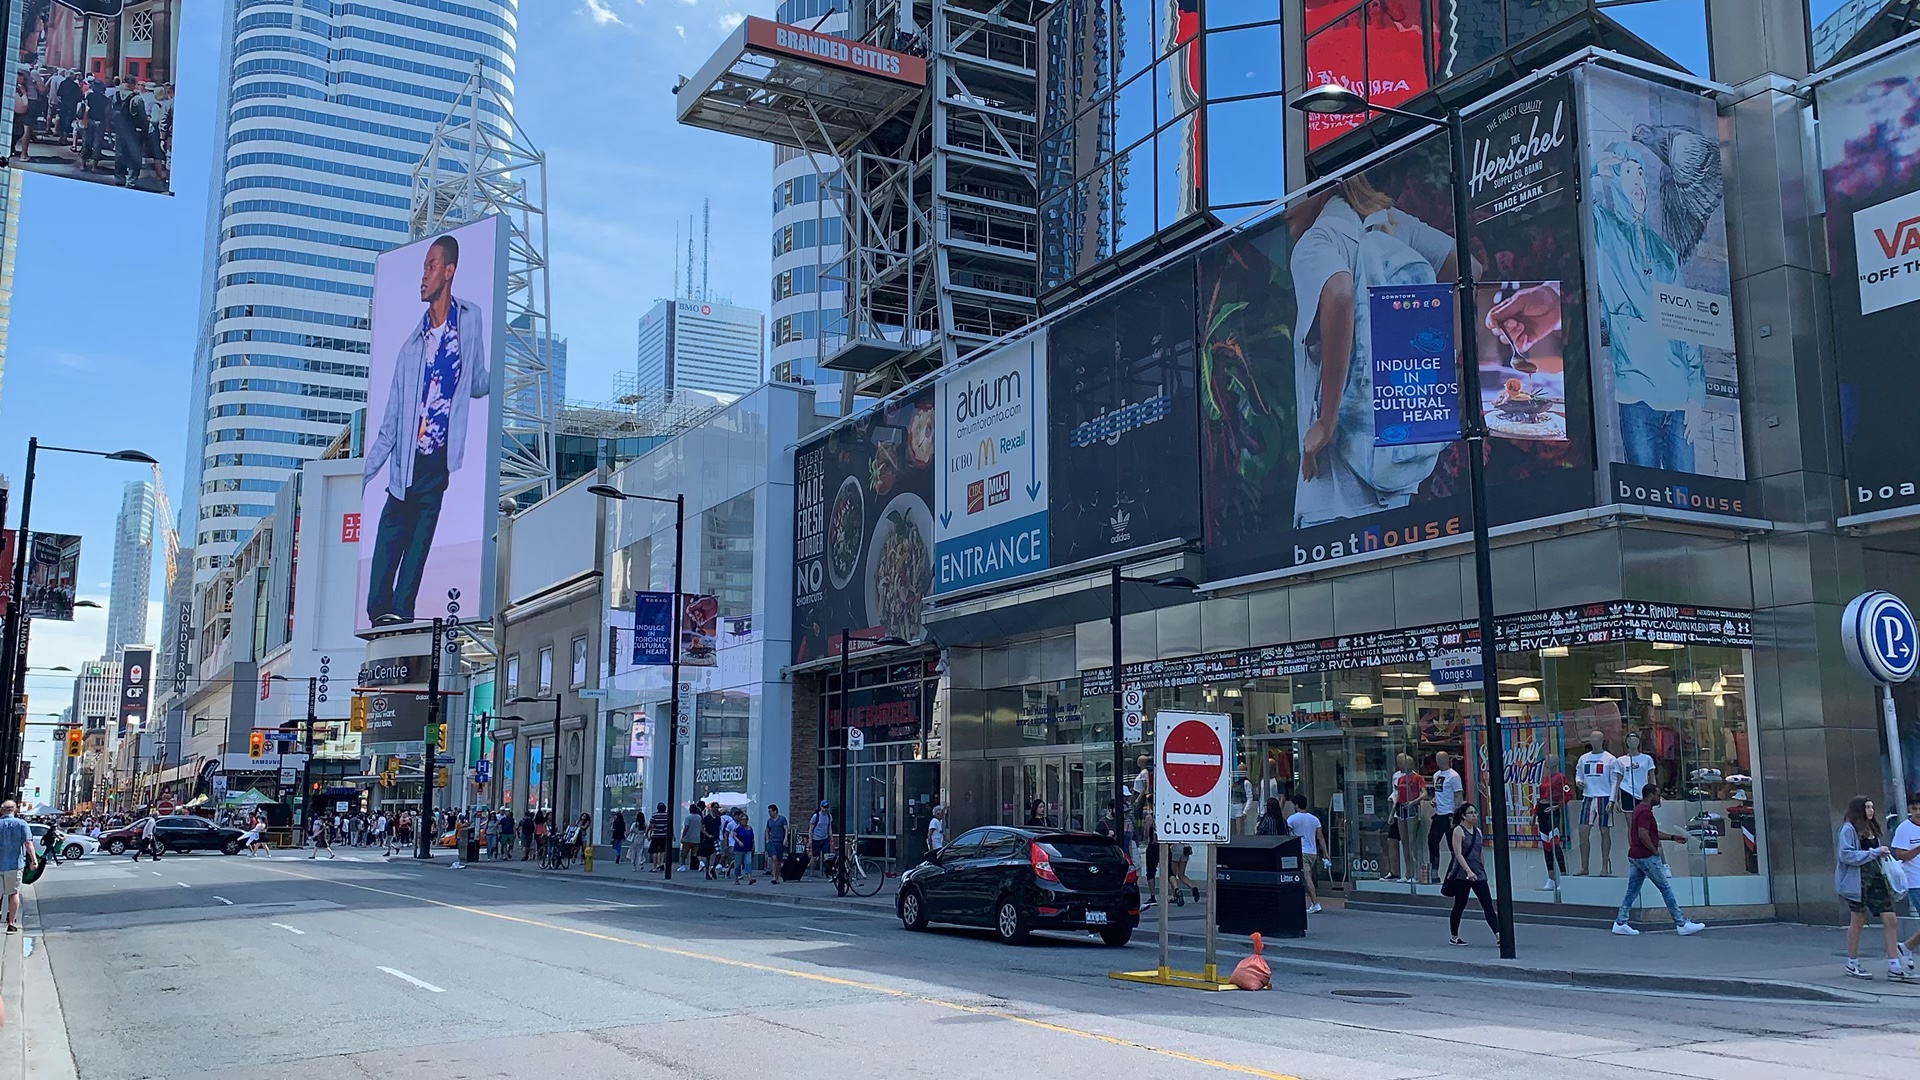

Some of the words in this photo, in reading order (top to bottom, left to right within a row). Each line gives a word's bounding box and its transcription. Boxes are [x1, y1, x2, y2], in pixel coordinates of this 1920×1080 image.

[777, 27, 848, 62] BRANDED
[851, 43, 900, 75] CITIES
[1486, 118, 1498, 133] THE
[1497, 105, 1518, 125] FINEST
[1518, 99, 1543, 114] QUALITY
[1510, 133, 1521, 146] THE
[1468, 100, 1565, 198] Herschel
[1493, 172, 1513, 189] SUPPLY
[1514, 169, 1523, 180] CO.
[1524, 160, 1543, 176] BRAND
[1493, 196, 1518, 212] TRADE
[1520, 184, 1544, 202] MARK
[1659, 292, 1692, 309] RVCA
[679, 302, 700, 312] BMO
[1376, 357, 1441, 372] INDULGE
[1404, 372, 1419, 383] IN
[956, 370, 1021, 423] atrium
[1375, 383, 1458, 398] TORONTO'S
[1372, 397, 1446, 411] CULTURAL
[956, 403, 1022, 439] atriumtoronto.com
[1403, 409, 1451, 422] HEART
[1000, 429, 1026, 454] Rexall
[799, 446, 825, 469] EVERY
[951, 450, 973, 473] LCBO
[798, 460, 825, 483] MEAL
[968, 483, 983, 498] CIBC
[988, 473, 1009, 496] MUJI
[798, 475, 825, 510] MADE
[1618, 480, 1743, 513] boathouse
[798, 502, 824, 540] FRESH
[1110, 532, 1131, 544] adidas
[1294, 516, 1460, 565] boathouse
[797, 539, 805, 560] TO
[805, 533, 824, 557] ORDER
[940, 528, 1041, 584] ENTRANCE
[797, 559, 823, 596] NO
[796, 592, 823, 607] SHORTCUTS
[1583, 604, 1605, 616] VANS
[1696, 609, 1716, 617] NIXON
[1724, 611, 1751, 619] BILLABONG
[1520, 614, 1542, 623] NIXON
[1603, 620, 1625, 628] RVCA
[1625, 619, 1640, 627] FILA
[1641, 620, 1666, 629] RVCA
[1409, 627, 1436, 636] BILLABONG
[1436, 624, 1458, 633] RVCA
[1520, 622, 1536, 630] CALVIN
[1552, 626, 1575, 635] Timberland
[1666, 620, 1690, 631] CALVIN
[1690, 622, 1709, 632] KLEIN
[1442, 633, 1462, 645] OBEY
[1588, 630, 1608, 642] OBEY
[1656, 631, 1687, 642] ELEMENT
[1687, 633, 1721, 644] Champion
[1728, 637, 1753, 645] VOLCOM
[1881, 616, 1904, 659] P
[175, 604, 190, 691] NORDSTROM
[433, 621, 441, 669] DOWNTOWN
[1295, 643, 1312, 651] NIXON
[1520, 636, 1560, 651] RVCA
[1322, 652, 1345, 660] TOMMY
[1353, 648, 1380, 657] HILFIGER
[1328, 658, 1359, 670] RVCA
[1360, 655, 1381, 667] FILA
[1382, 654, 1407, 664] NIXON
[374, 664, 408, 680] Centre
[1206, 661, 1223, 672] FILA
[1261, 667, 1276, 677] OBEY
[1283, 663, 1309, 674] ELEMENT
[1176, 676, 1197, 685] ELEMENT
[1203, 672, 1231, 682] VOLCOM
[1439, 669, 1465, 682] Yonge
[1466, 669, 1473, 678] St
[1141, 680, 1159, 689] NIXON
[126, 687, 143, 698] CF
[1083, 686, 1103, 696] RVCA
[1265, 707, 1335, 726] boathouse
[478, 761, 487, 772] H
[1172, 802, 1212, 815] ROAD
[1163, 822, 1220, 835] CLOSED
[1280, 874, 1294, 883] Litter
